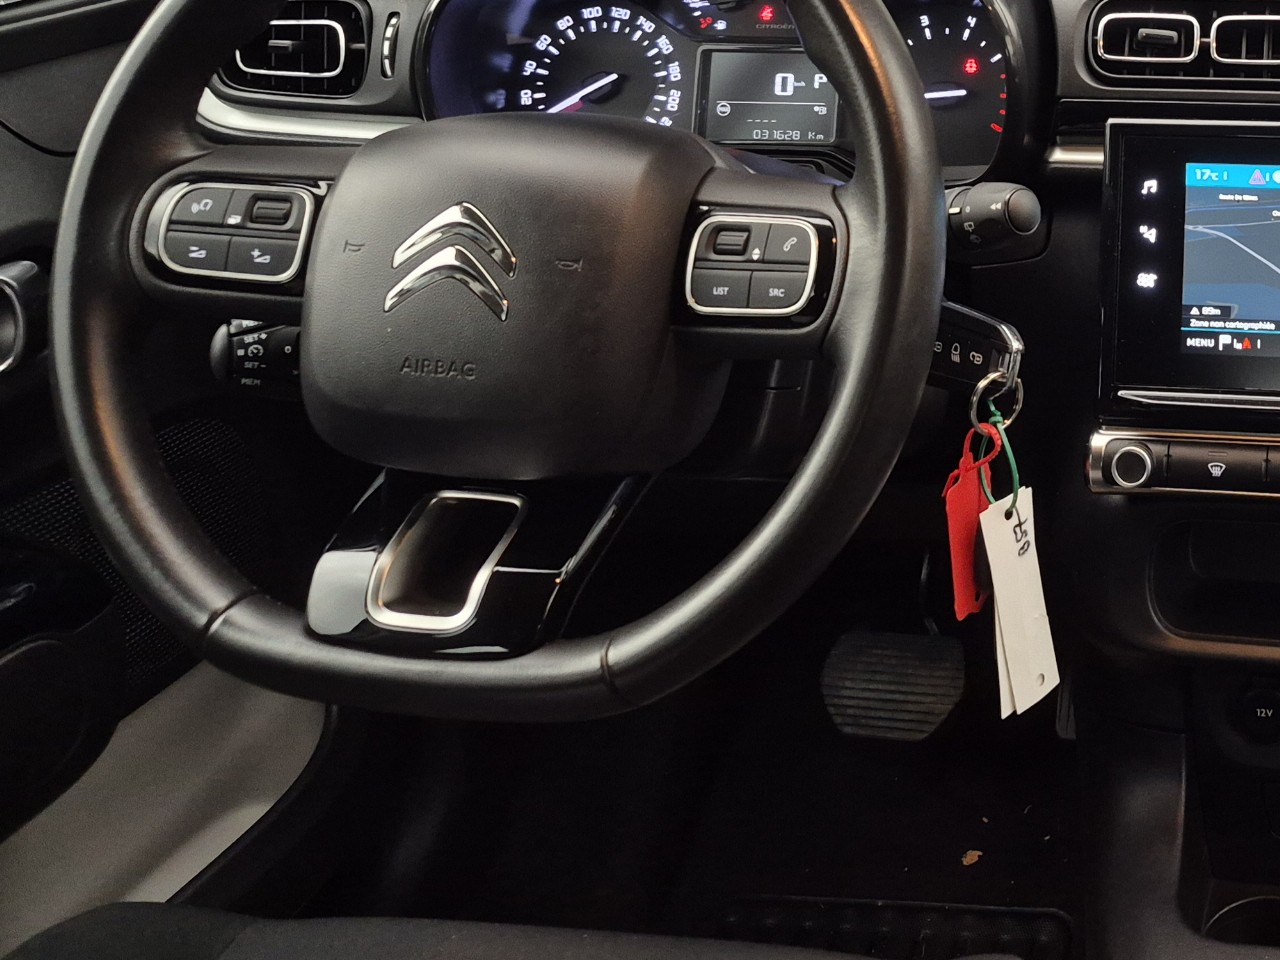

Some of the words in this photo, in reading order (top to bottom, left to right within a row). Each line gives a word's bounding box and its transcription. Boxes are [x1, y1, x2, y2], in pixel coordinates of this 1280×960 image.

[581, 6, 603, 20] 100
[611, 6, 631, 20] 120
[556, 16, 574, 31] 80
[636, 15, 656, 33] 140
[920, 15, 929, 27] 3
[967, 15, 977, 28] 4
[535, 34, 551, 51] 60
[656, 35, 674, 55] 160
[522, 60, 537, 76] 40
[667, 61, 681, 82] 180
[520, 89, 532, 106] 20
[666, 89, 681, 112] 200
[753, 129, 801, 140] 031628
[712, 286, 730, 296] LIST
[768, 287, 786, 297] SRC
[1186, 337, 1215, 348] MENU
[399, 355, 477, 380] AIRBAG
[1256, 708, 1273, 718] 12V
